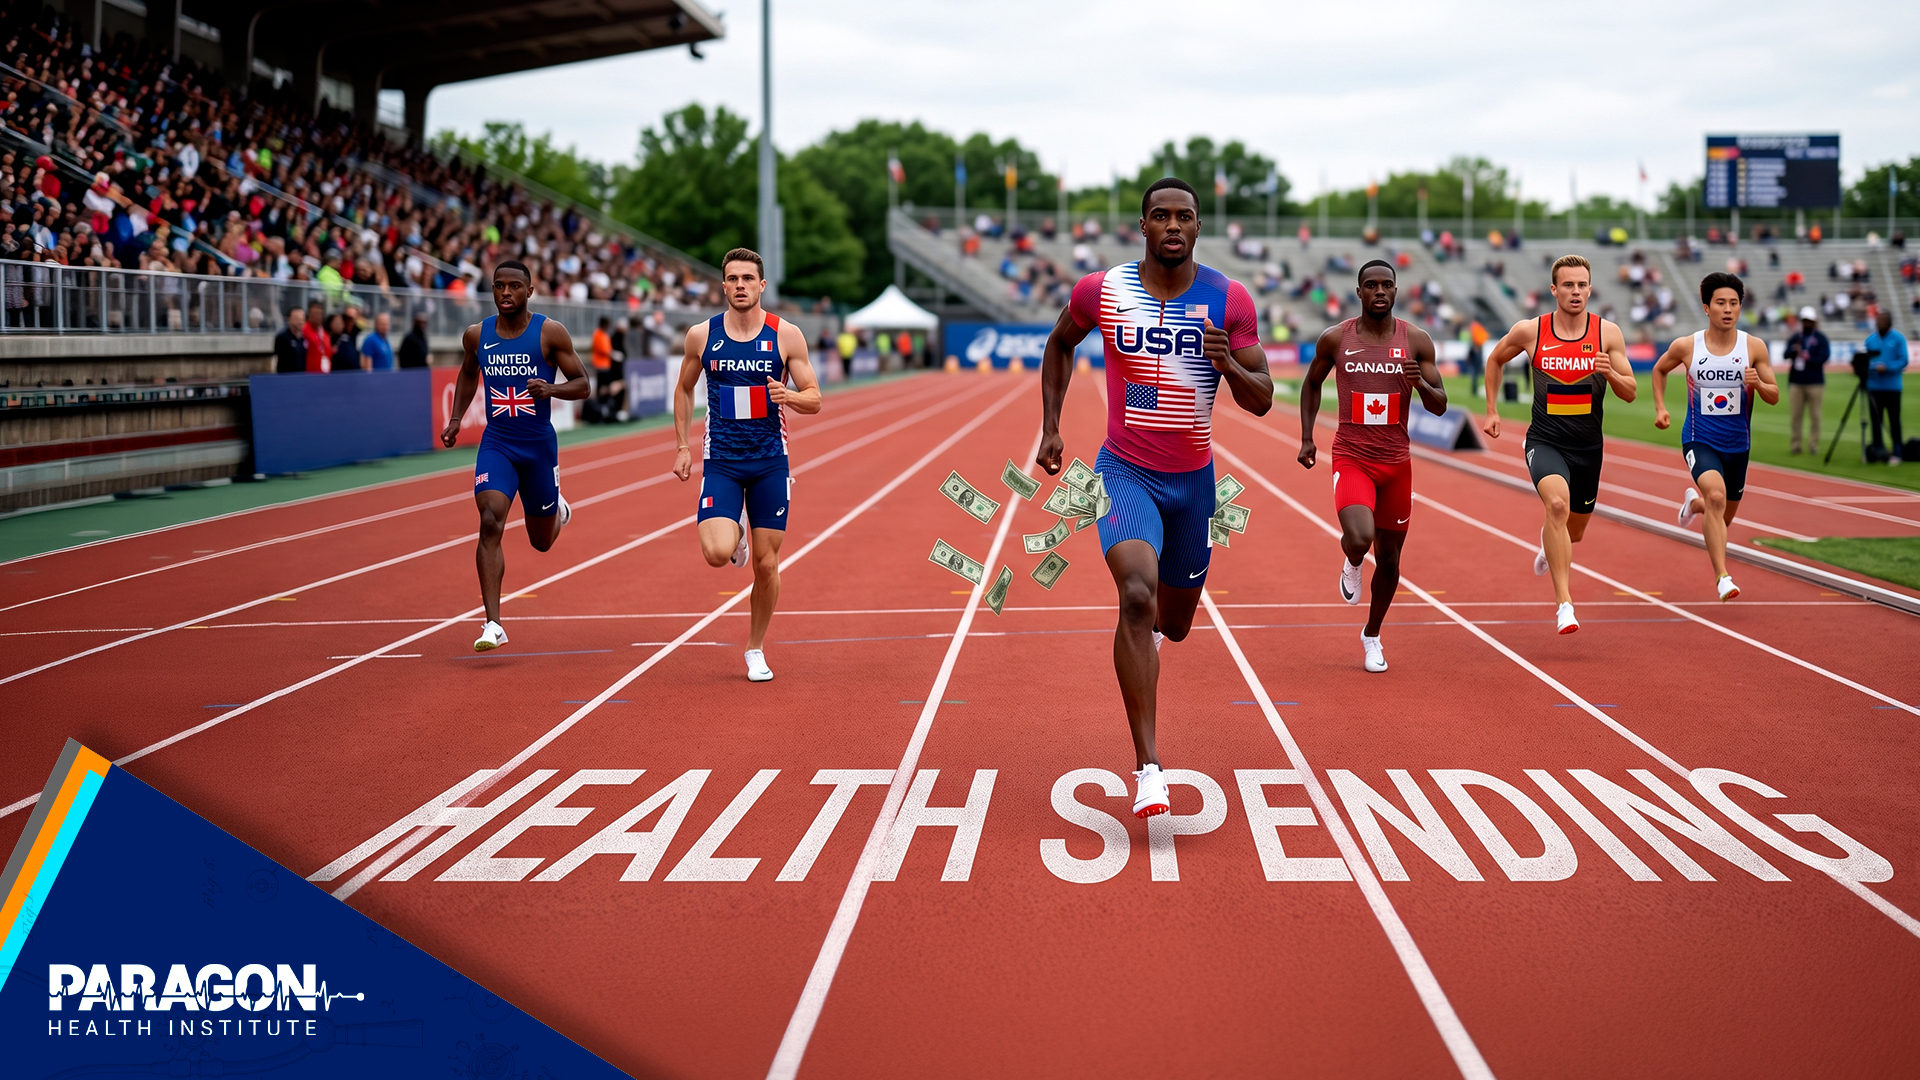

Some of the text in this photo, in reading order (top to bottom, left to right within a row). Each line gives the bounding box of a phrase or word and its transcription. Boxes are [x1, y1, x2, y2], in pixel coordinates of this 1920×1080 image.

[1115, 324, 1204, 357] USA
[488, 354, 531, 365] UNITED
[719, 359, 773, 372] FRANCE
[1541, 356, 1596, 371] GERMANY
[484, 365, 538, 376] KINGDOM
[1344, 361, 1404, 374] CANADA
[1697, 369, 1743, 381] KOREA
[305, 767, 1895, 883] HEALTH SPENDING
